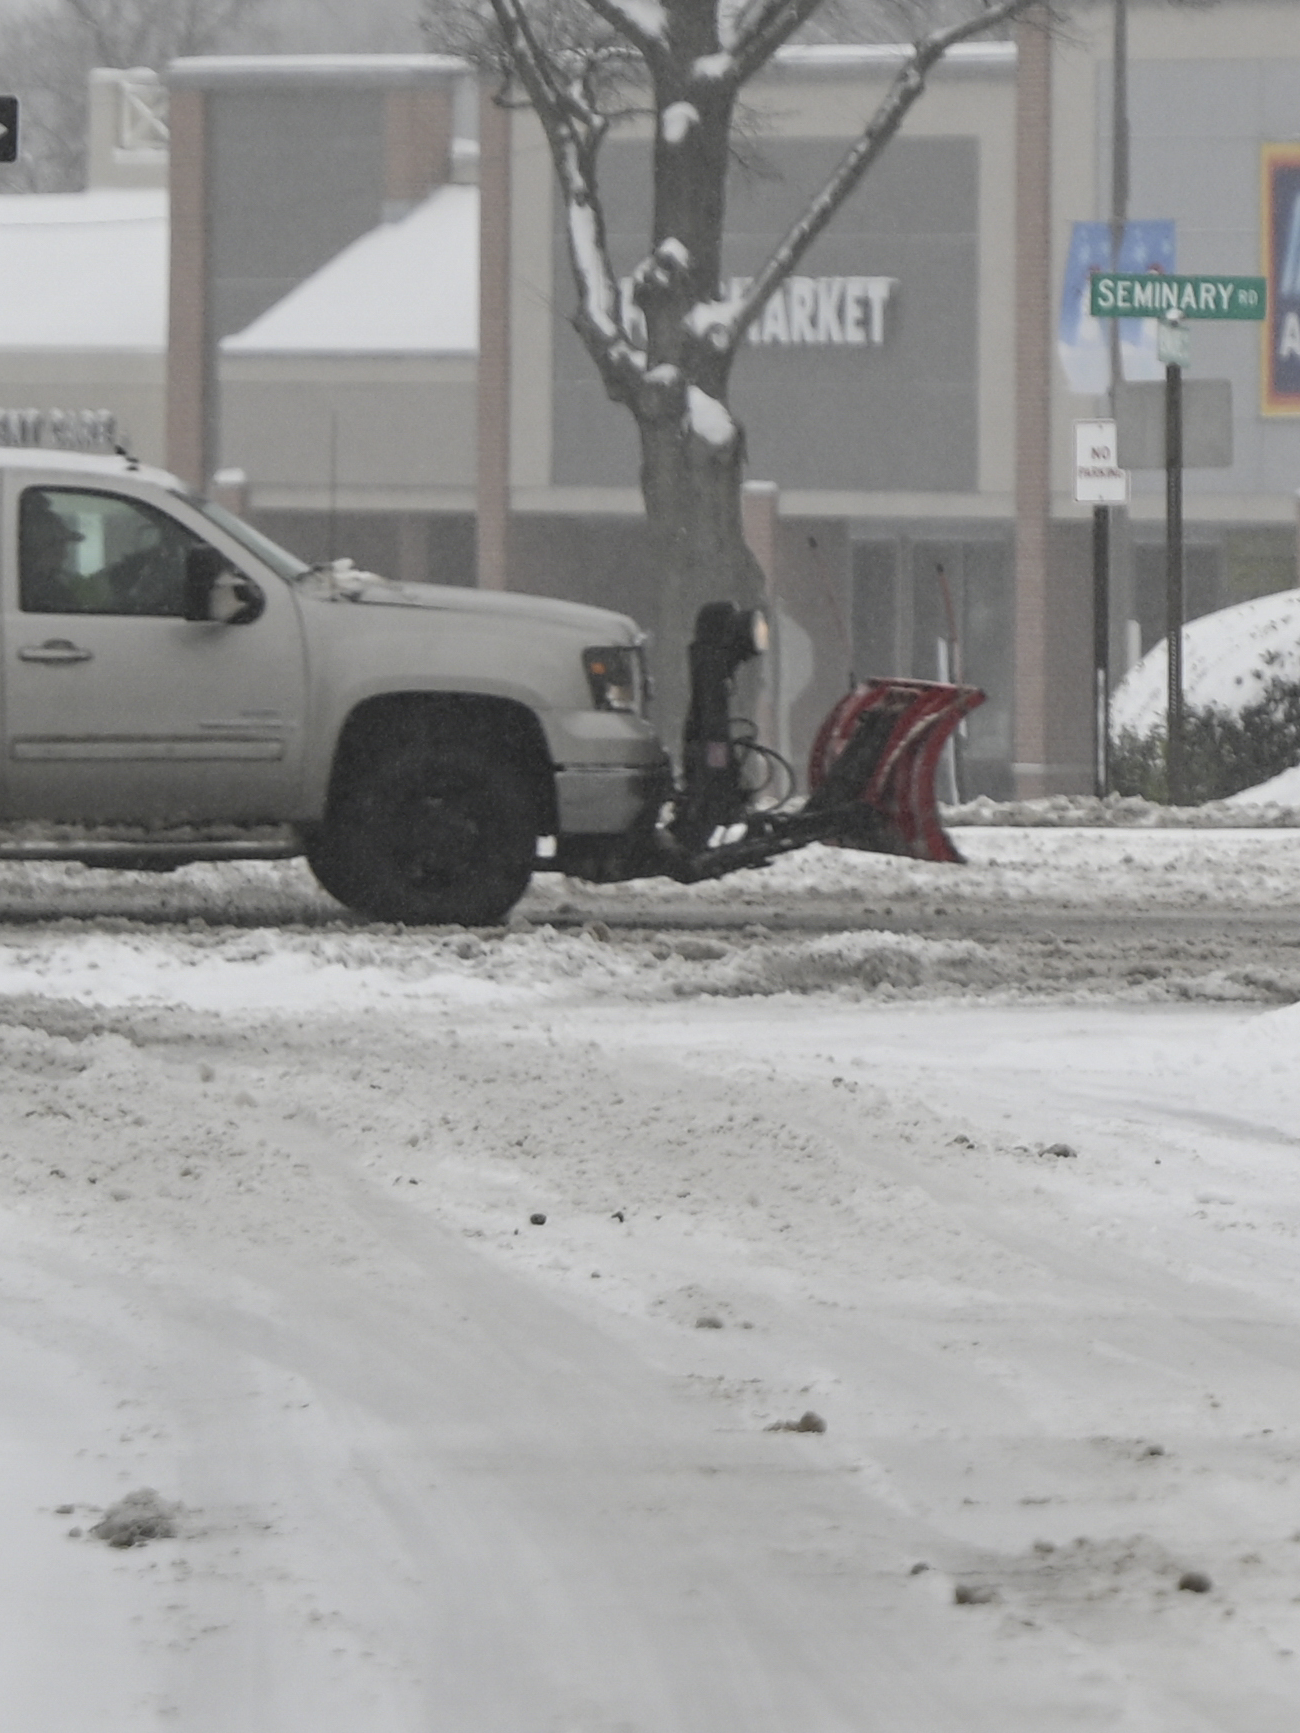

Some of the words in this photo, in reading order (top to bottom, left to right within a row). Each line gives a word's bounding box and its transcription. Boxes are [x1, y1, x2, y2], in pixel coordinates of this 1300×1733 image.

[1098, 278, 1235, 311] SEMINARY
[1238, 288, 1259, 306] RD
[1091, 445, 1111, 460] NO
